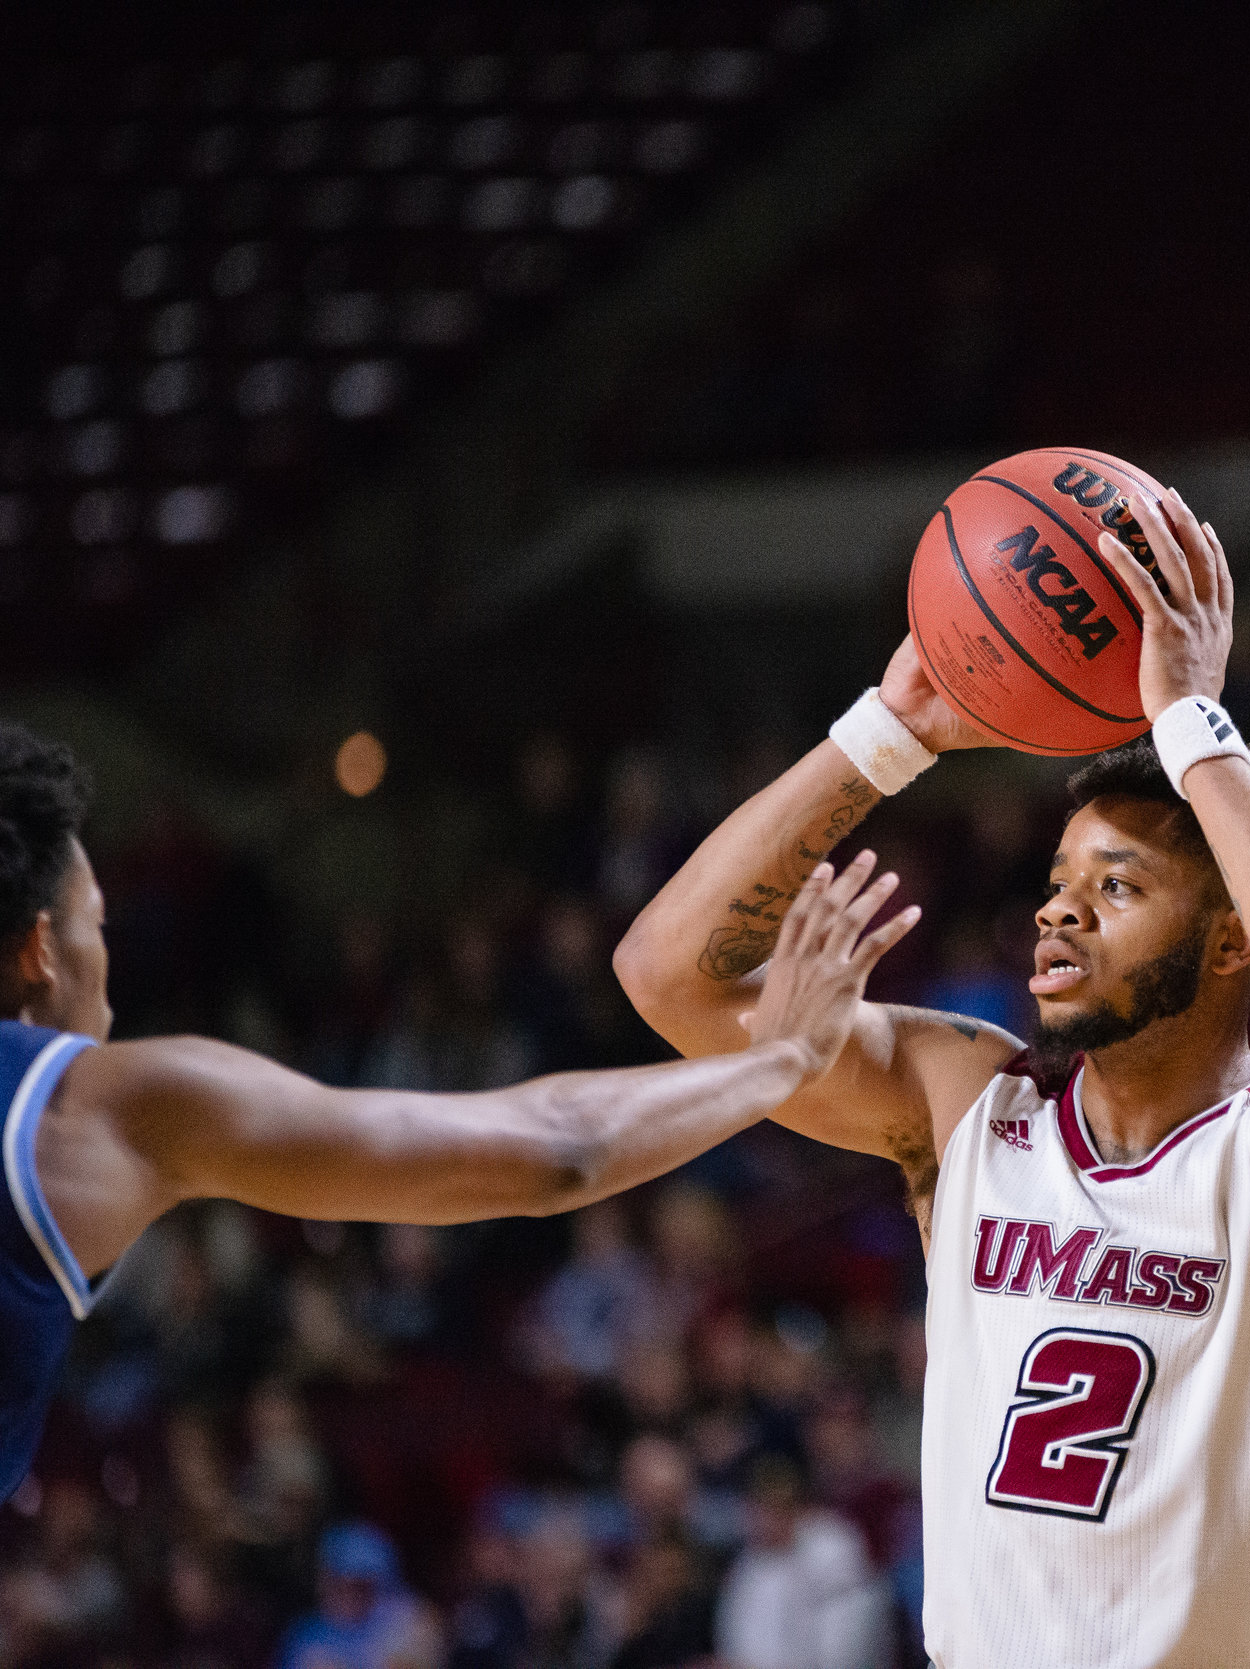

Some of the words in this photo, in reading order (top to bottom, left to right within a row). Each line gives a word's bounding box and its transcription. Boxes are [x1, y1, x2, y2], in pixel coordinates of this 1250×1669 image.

[996, 525, 1119, 660] NCAA
[989, 1119, 1033, 1151] adidas
[970, 1214, 1227, 1318] UMASS
[986, 1326, 1157, 1522] 2
